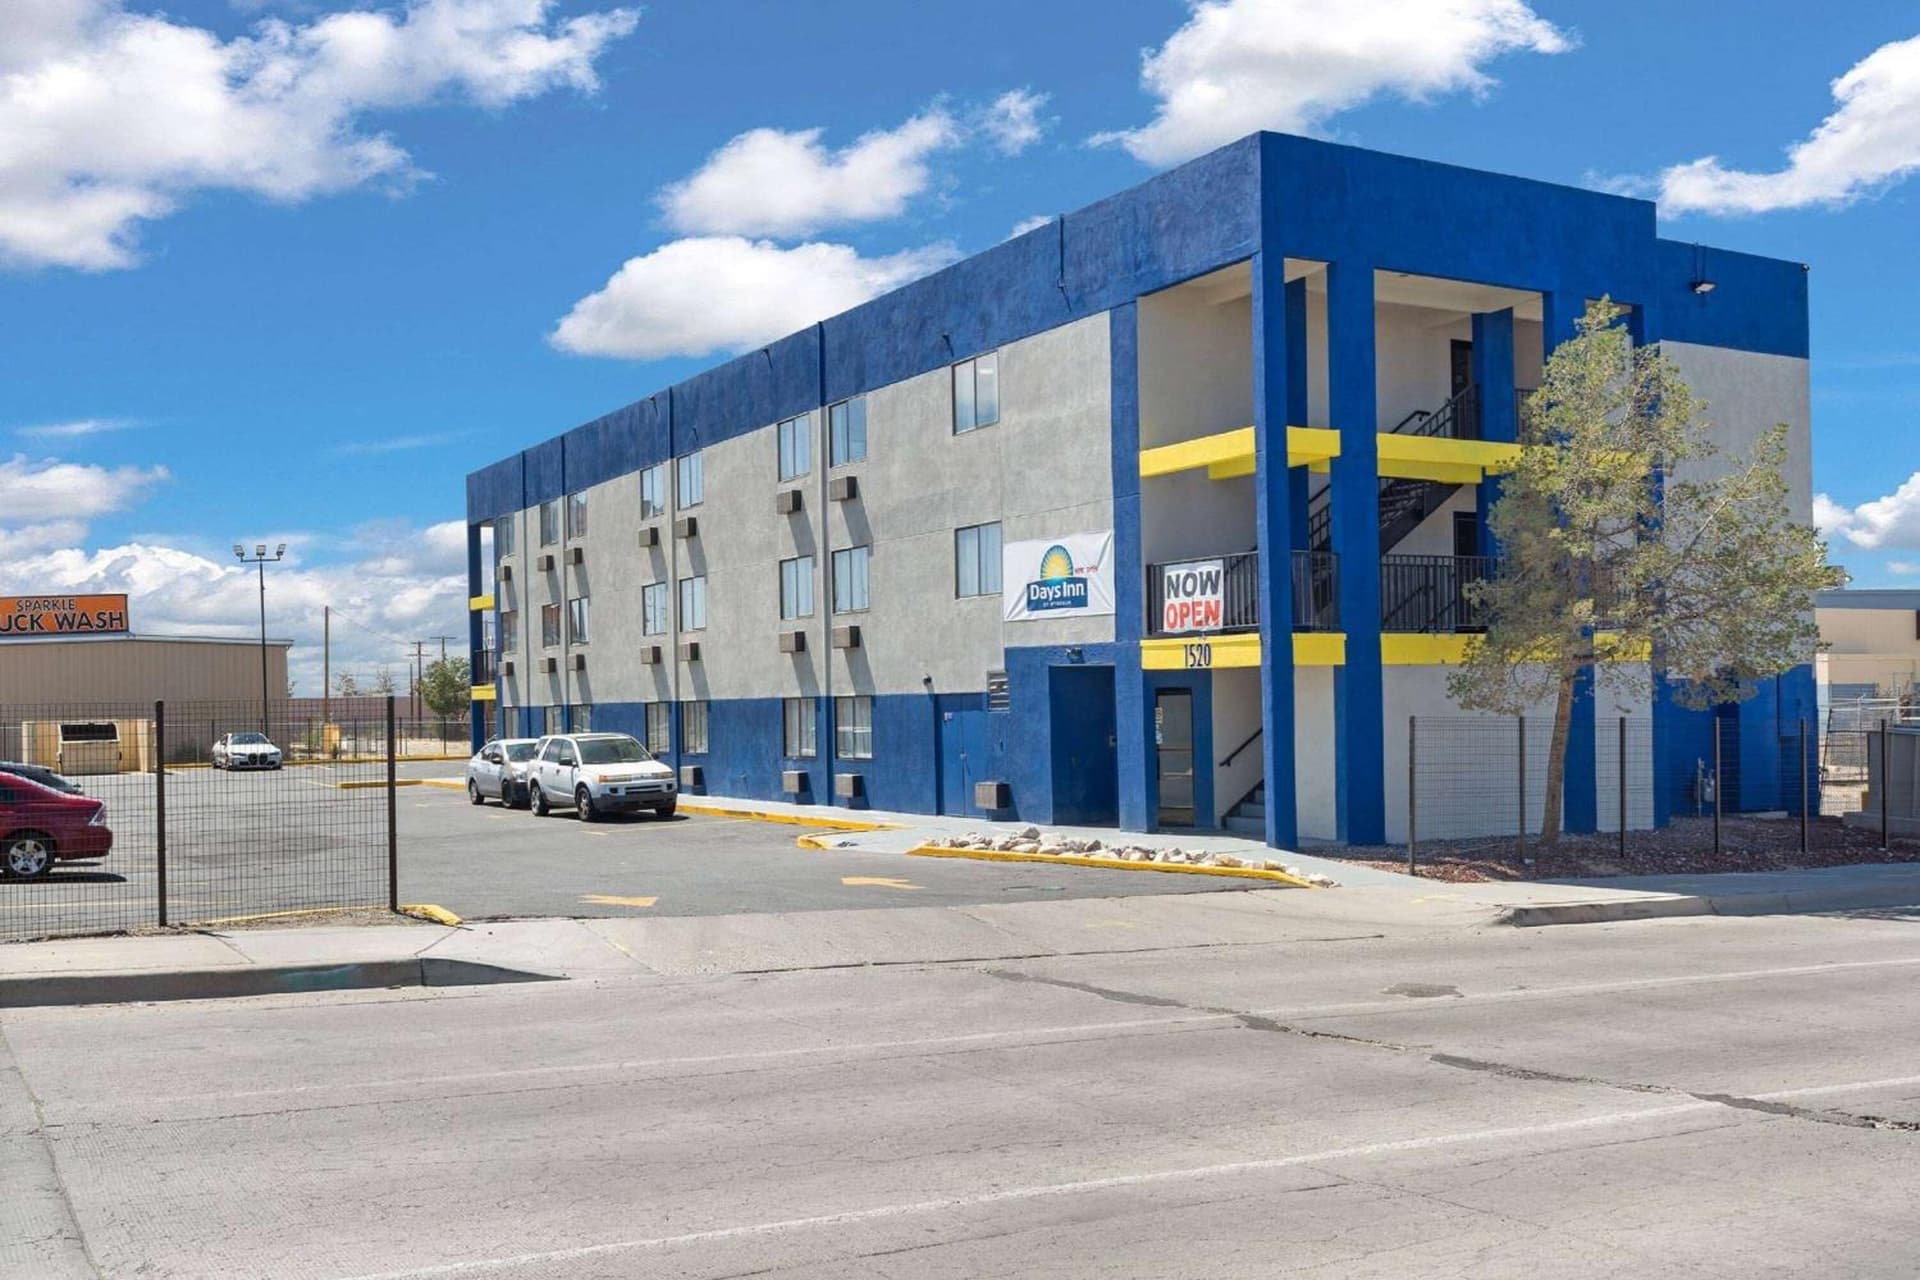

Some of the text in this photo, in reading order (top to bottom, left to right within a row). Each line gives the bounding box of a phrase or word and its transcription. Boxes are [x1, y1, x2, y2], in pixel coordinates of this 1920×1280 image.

[1030, 582, 1085, 601] Days Inn
[1166, 570, 1221, 599] NOW
[16, 598, 76, 612] SPARKLE
[1166, 599, 1221, 629] OPEN
[54, 611, 123, 630] WASH
[1184, 643, 1212, 668] 1520
